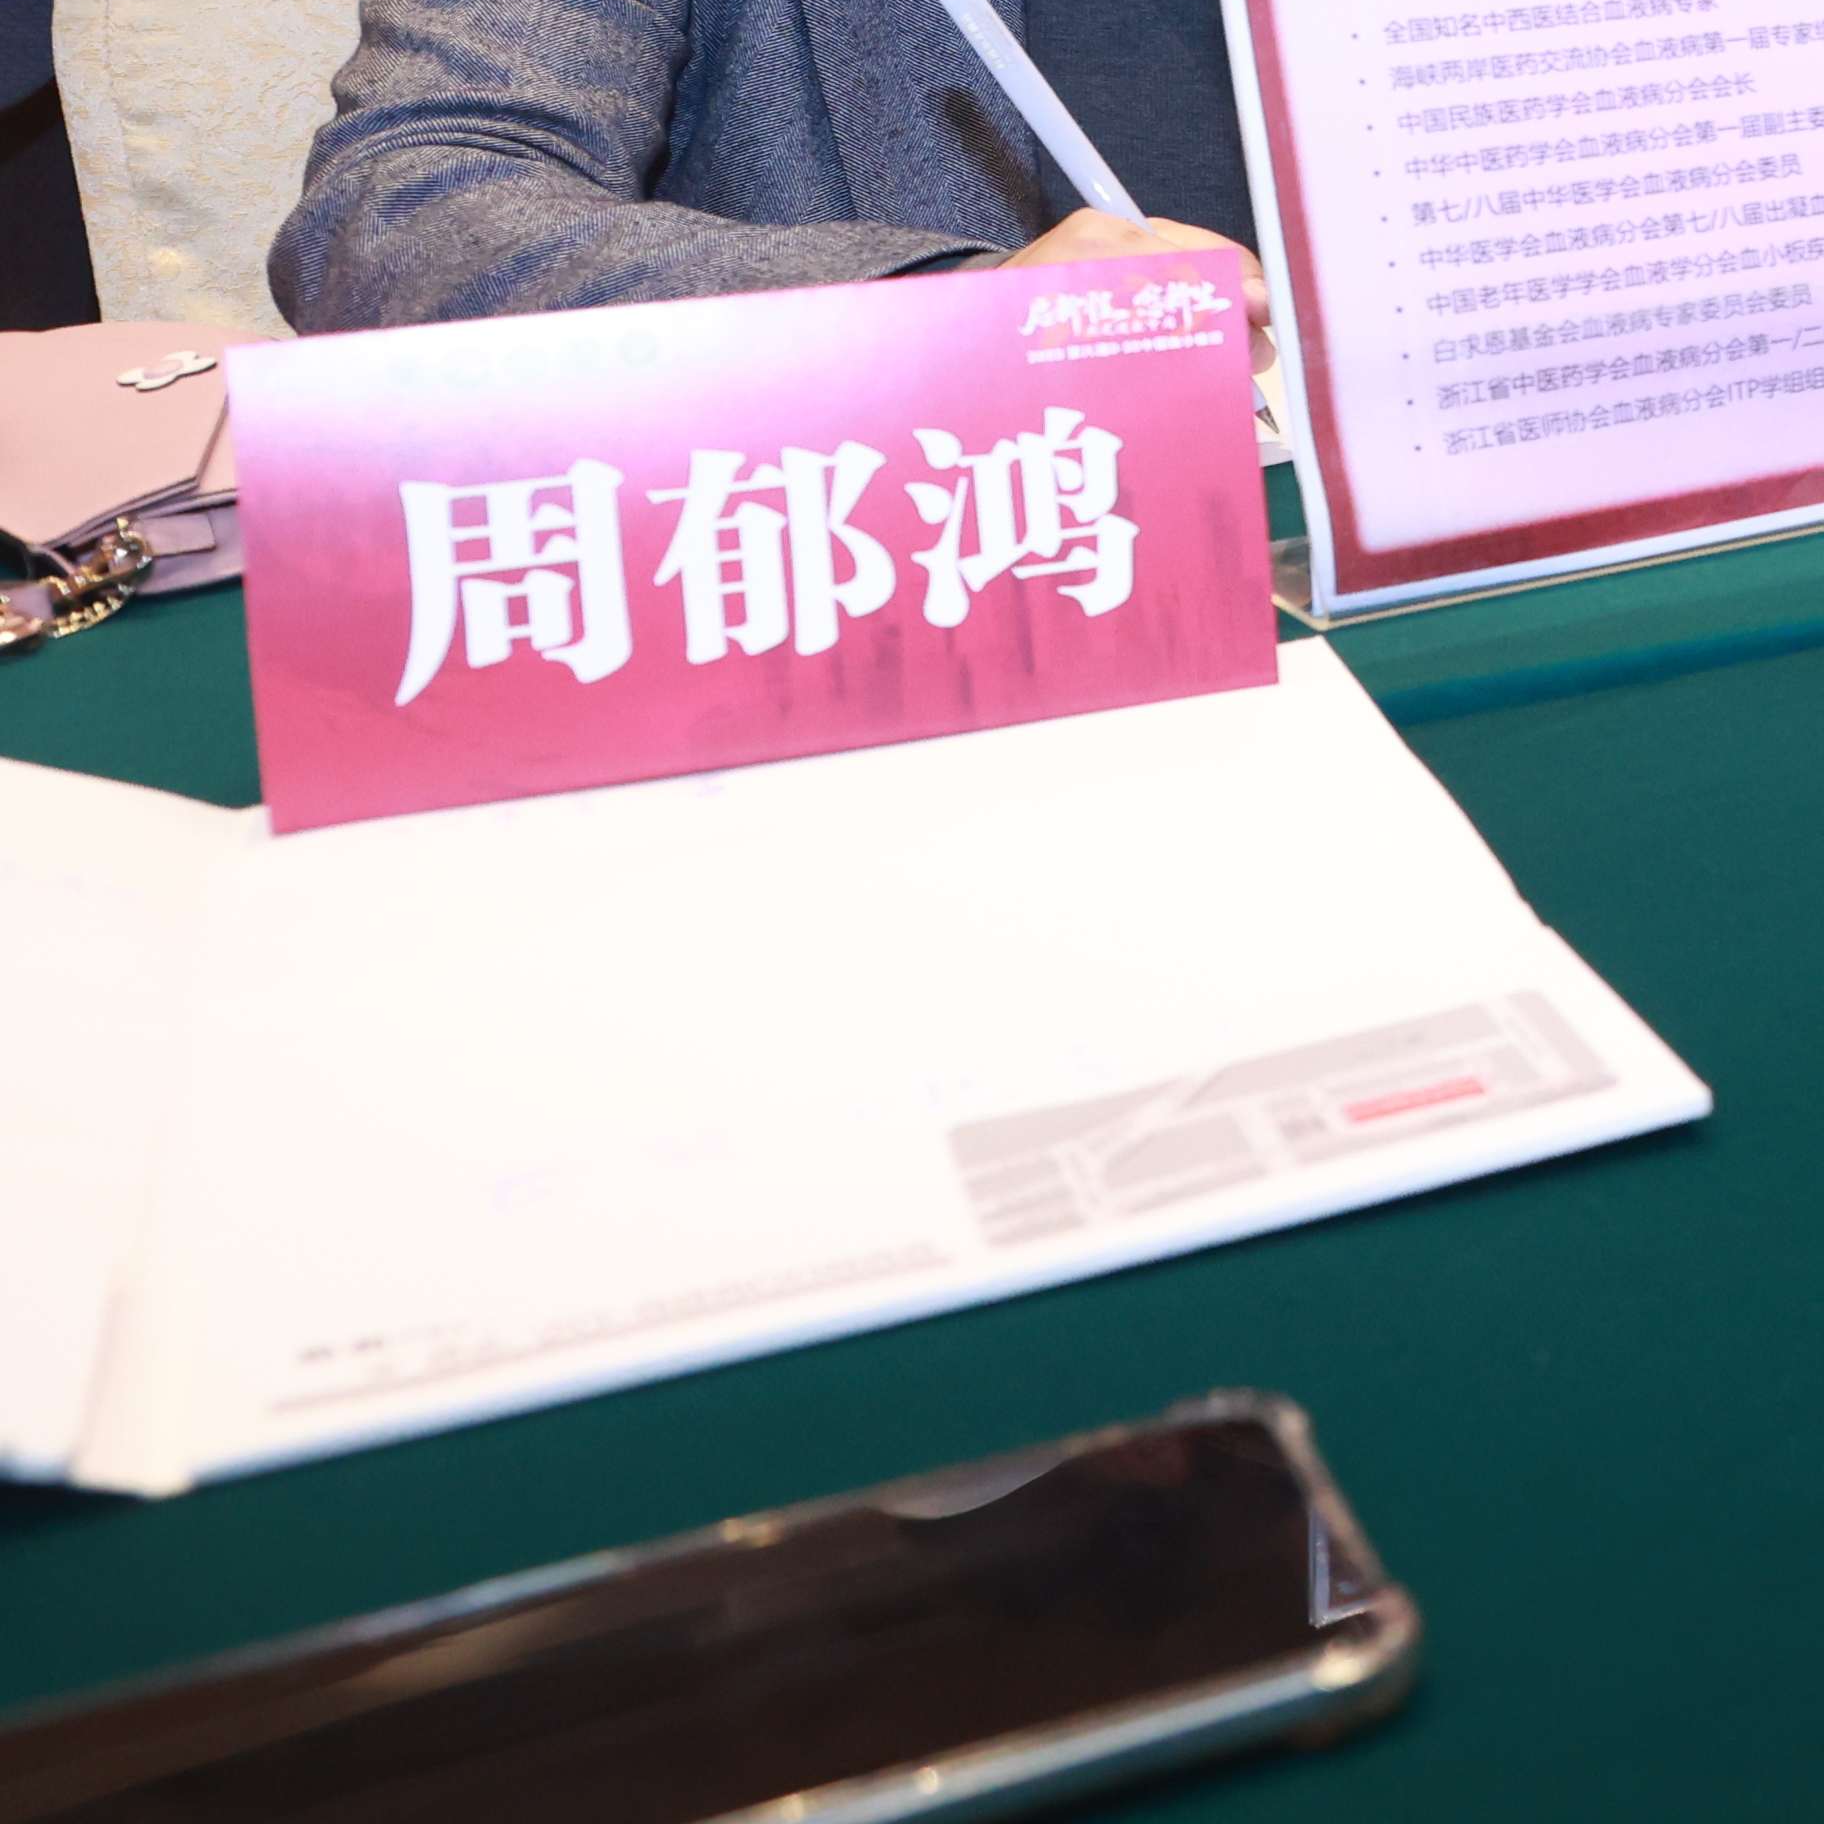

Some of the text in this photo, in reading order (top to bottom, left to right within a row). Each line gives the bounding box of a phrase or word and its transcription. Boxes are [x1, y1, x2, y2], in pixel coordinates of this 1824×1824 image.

[1397, 73, 1757, 134] 中国民族医药学会血液病分会会长
[394, 405, 1139, 707] 周郁鸿
